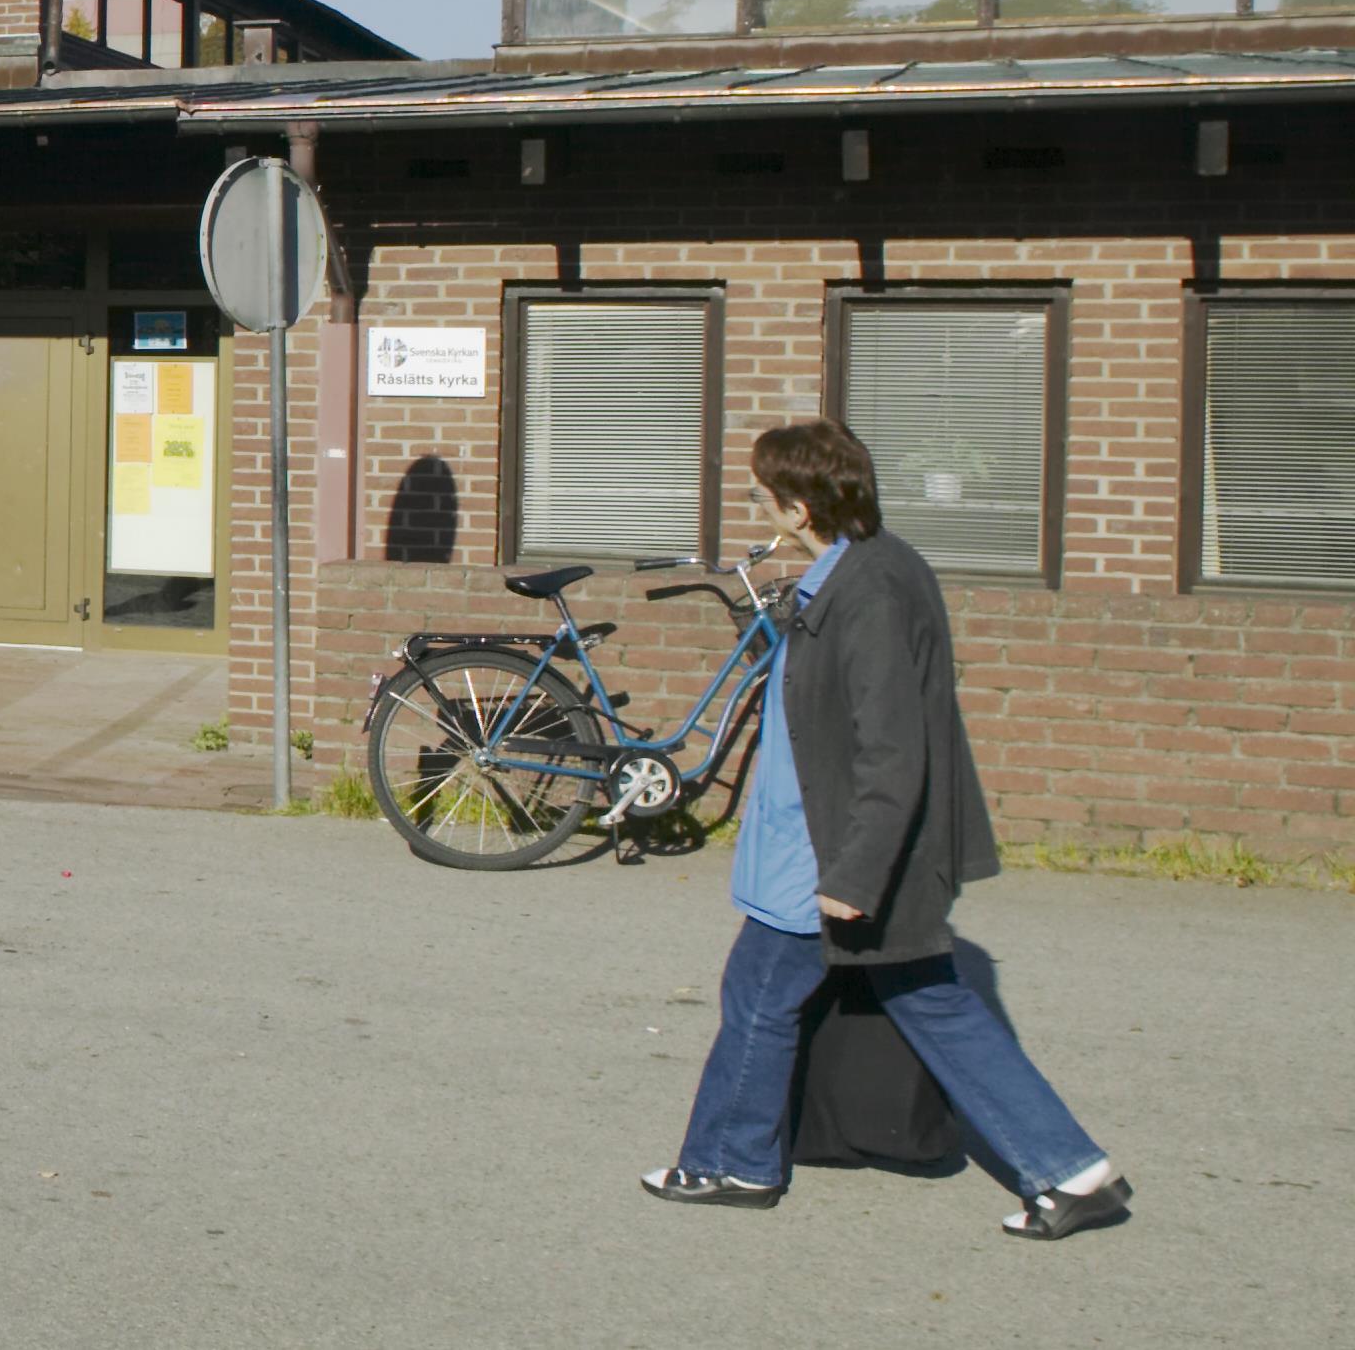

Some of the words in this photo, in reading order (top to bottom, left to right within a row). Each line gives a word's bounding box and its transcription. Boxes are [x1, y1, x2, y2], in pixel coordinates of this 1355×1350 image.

[410, 347, 446, 357] Svenska
[448, 347, 479, 359] Kyrkan
[377, 372, 434, 385] Råslätts
[439, 373, 478, 388] kyrka
